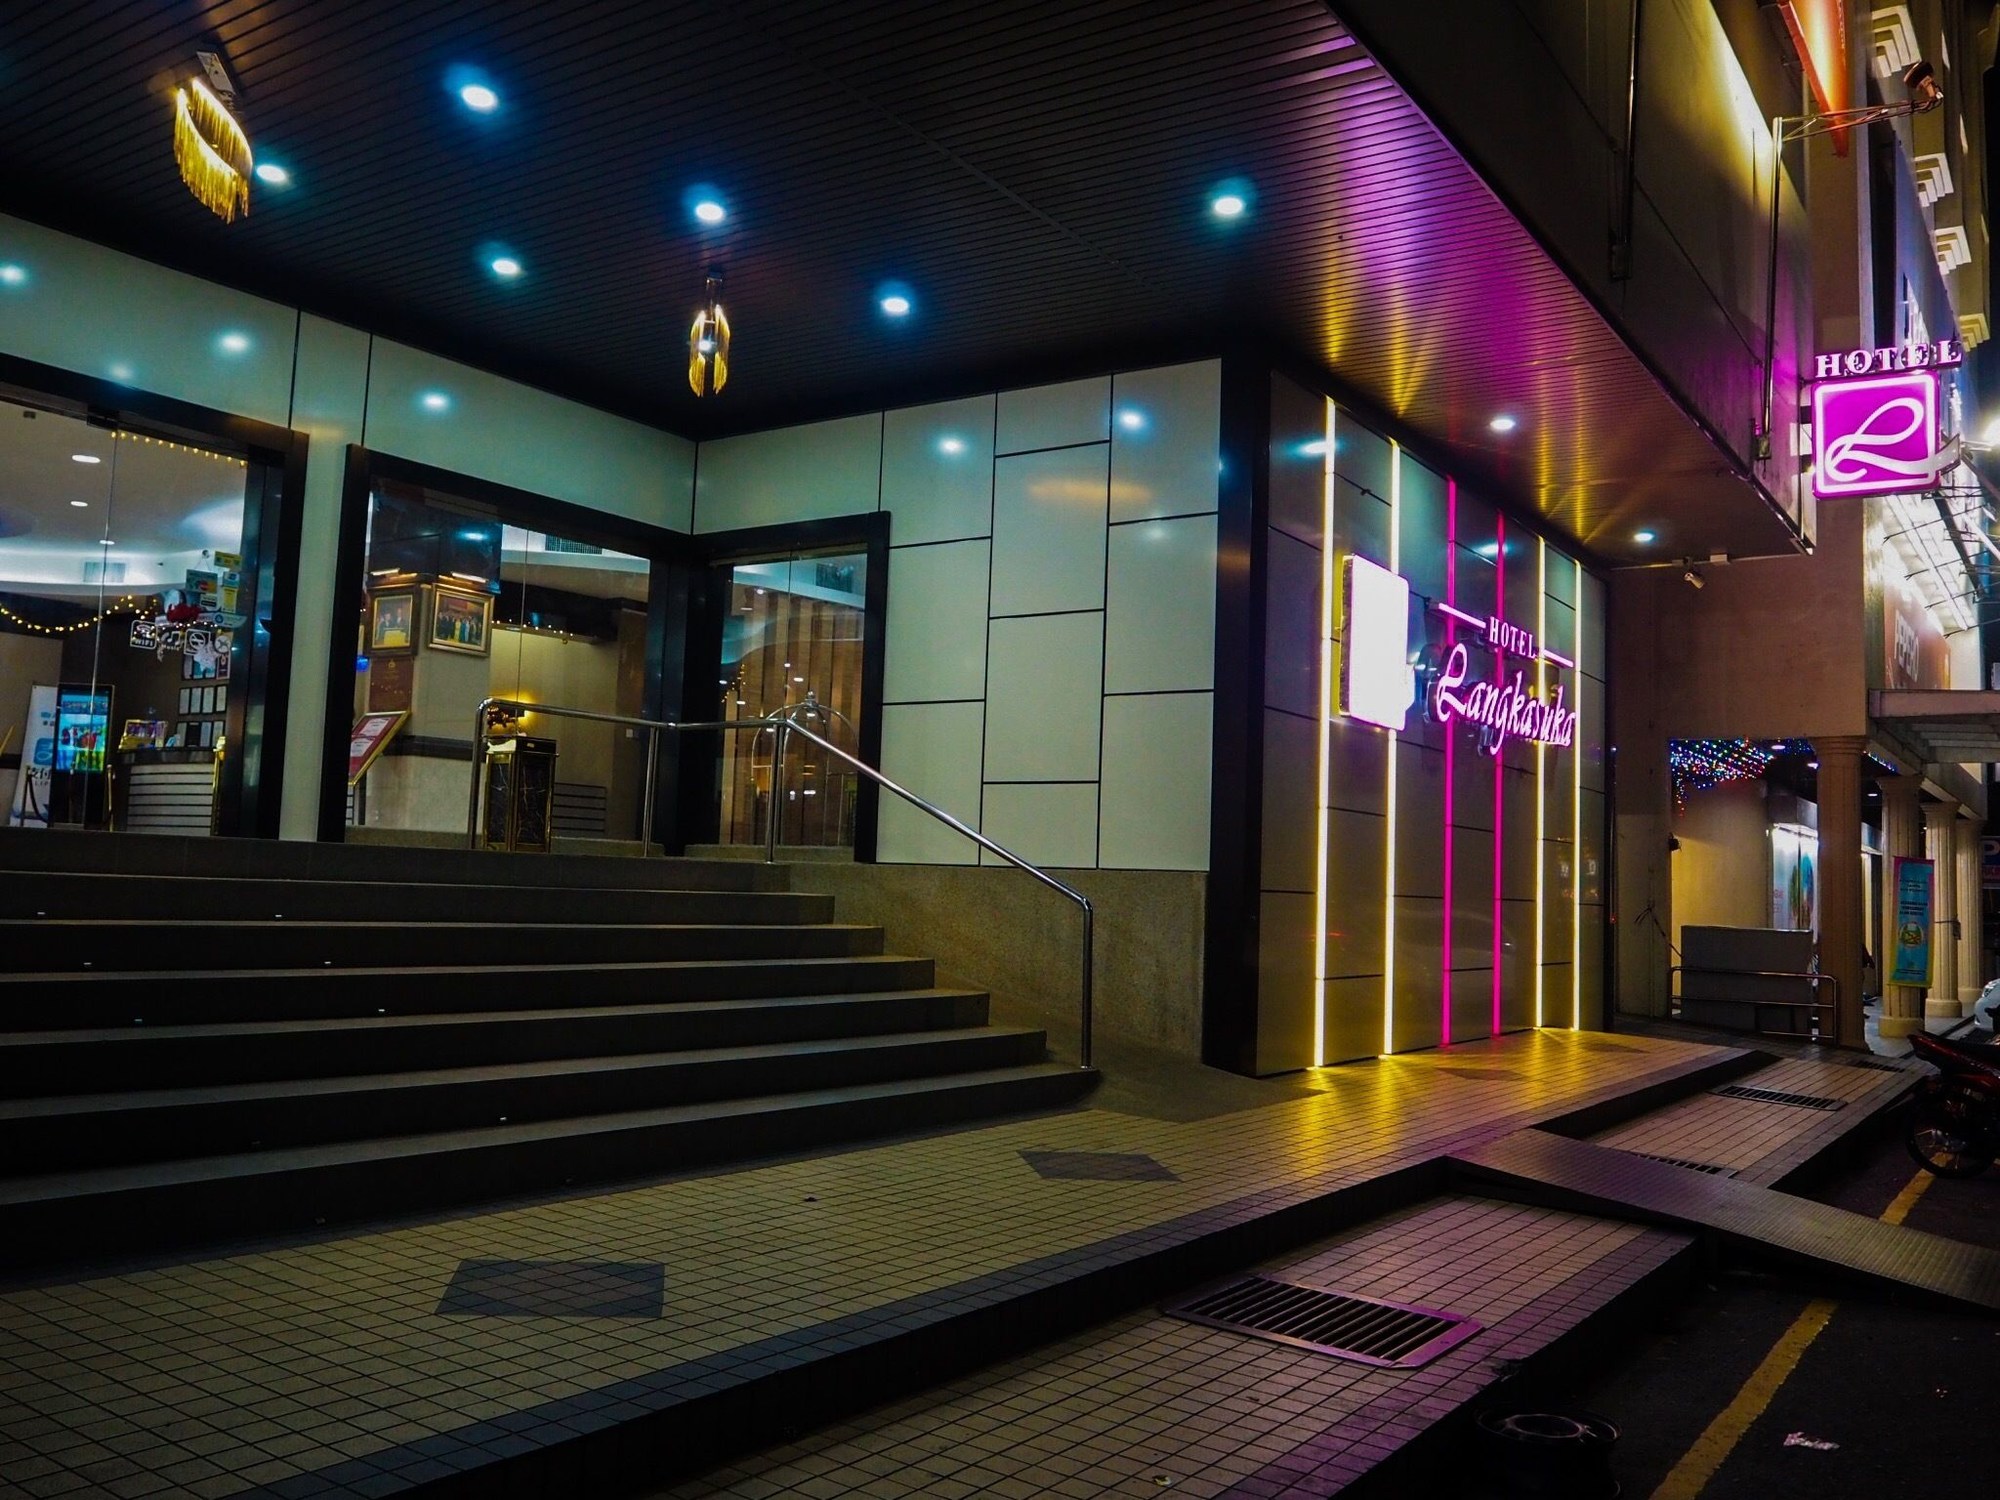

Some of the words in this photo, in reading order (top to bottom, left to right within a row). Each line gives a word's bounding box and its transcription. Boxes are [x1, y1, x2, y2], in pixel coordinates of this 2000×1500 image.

[1814, 340, 1962, 378] HOTEL
[1489, 616, 1536, 659] HOTEL
[1436, 642, 1576, 755] Langkasuka
